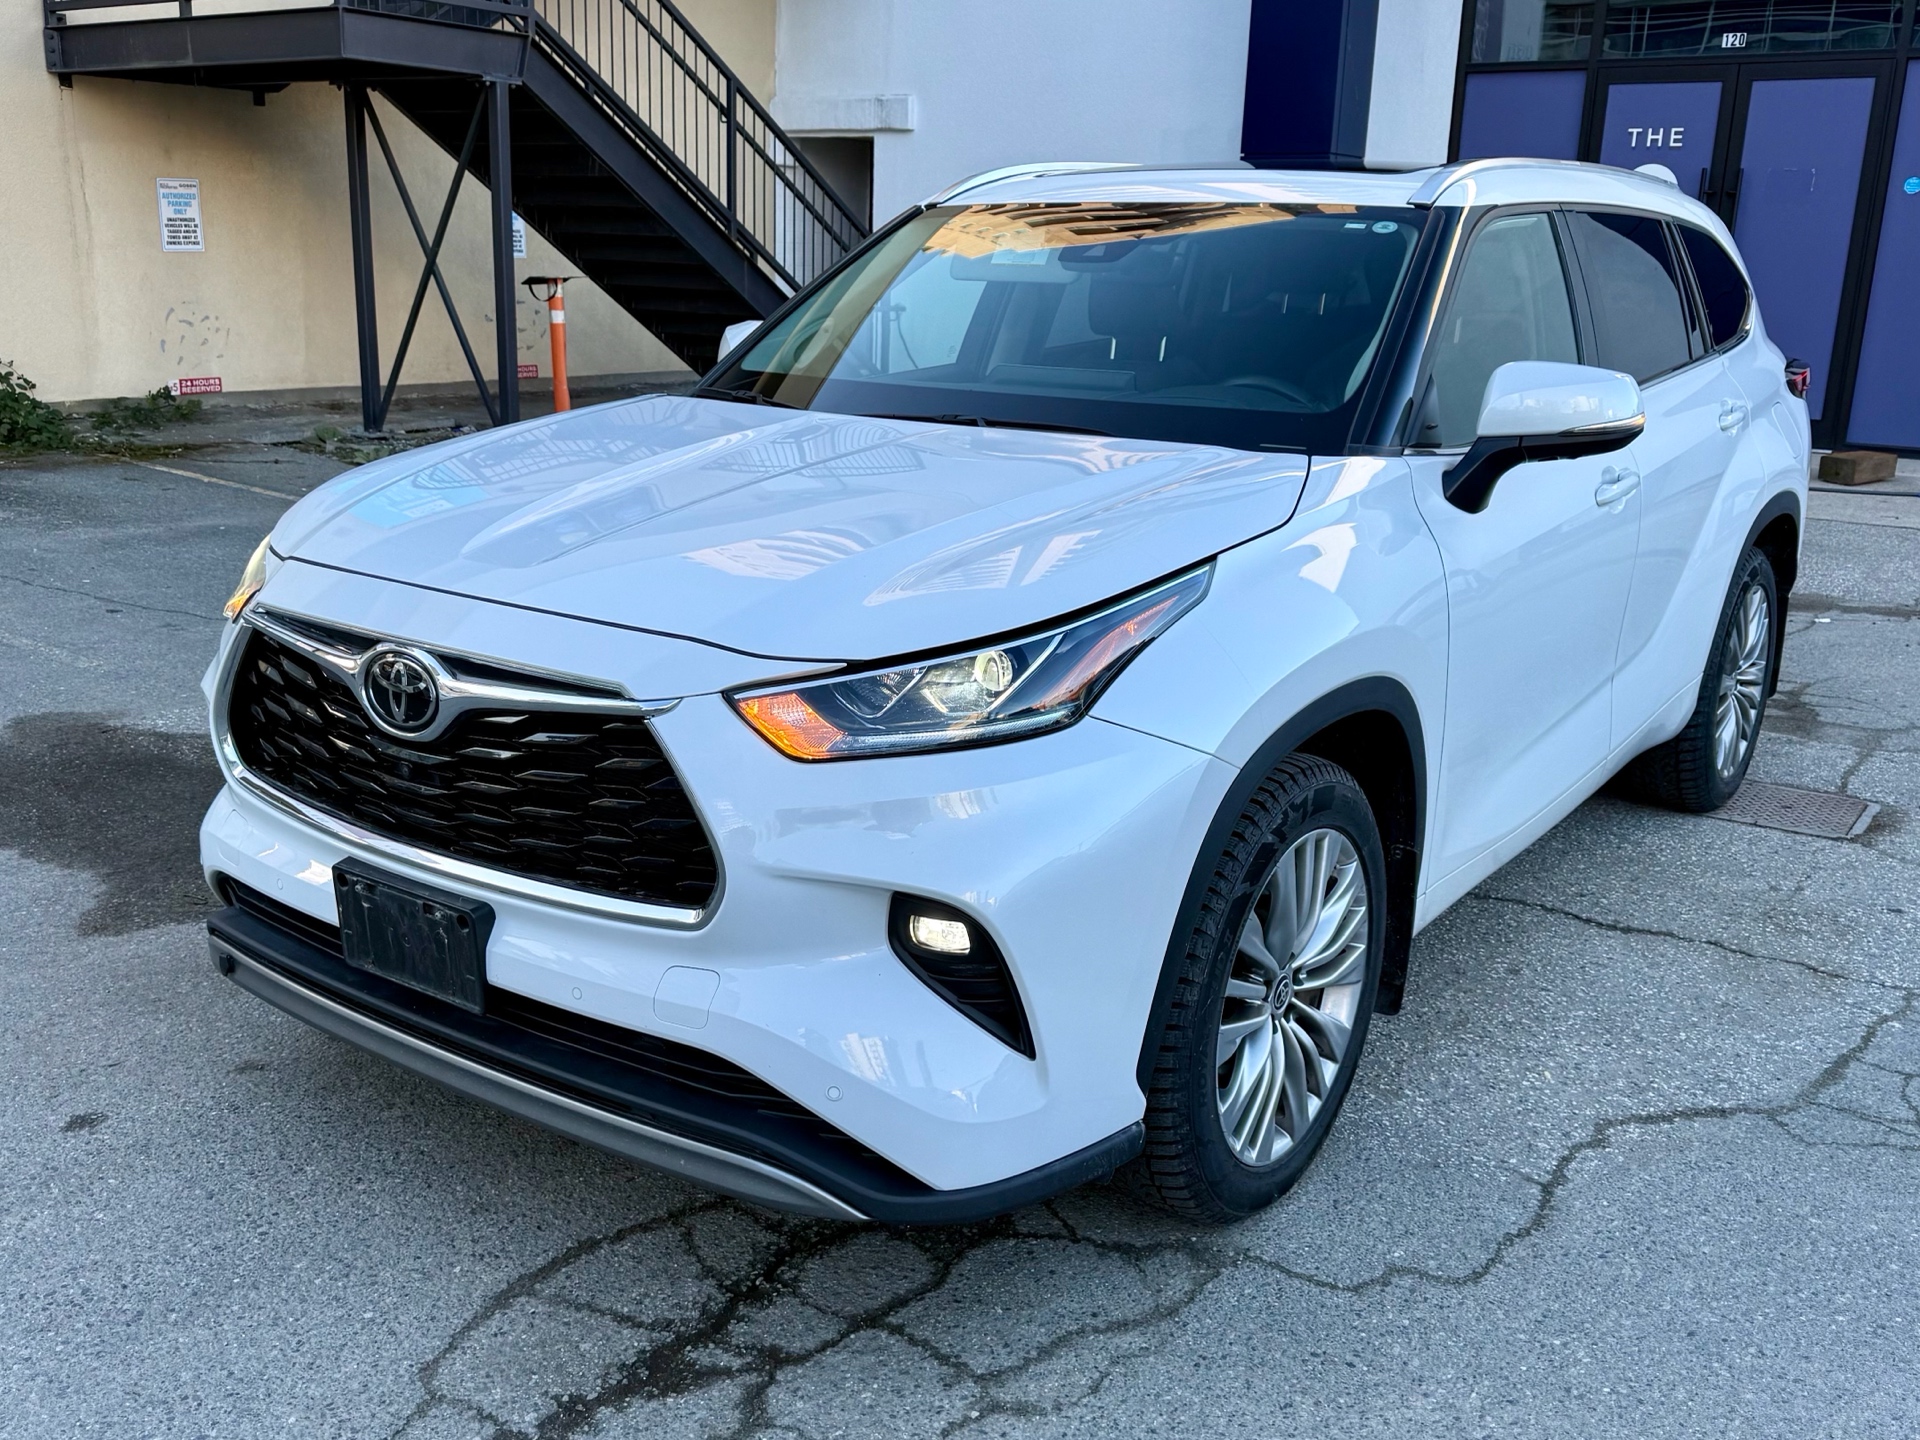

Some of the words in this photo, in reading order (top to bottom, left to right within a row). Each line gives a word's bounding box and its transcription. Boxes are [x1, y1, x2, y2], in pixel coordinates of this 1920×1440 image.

[1724, 33, 1746, 47] 120
[1627, 127, 1685, 147] THE
[181, 385, 221, 394] RESERVED
